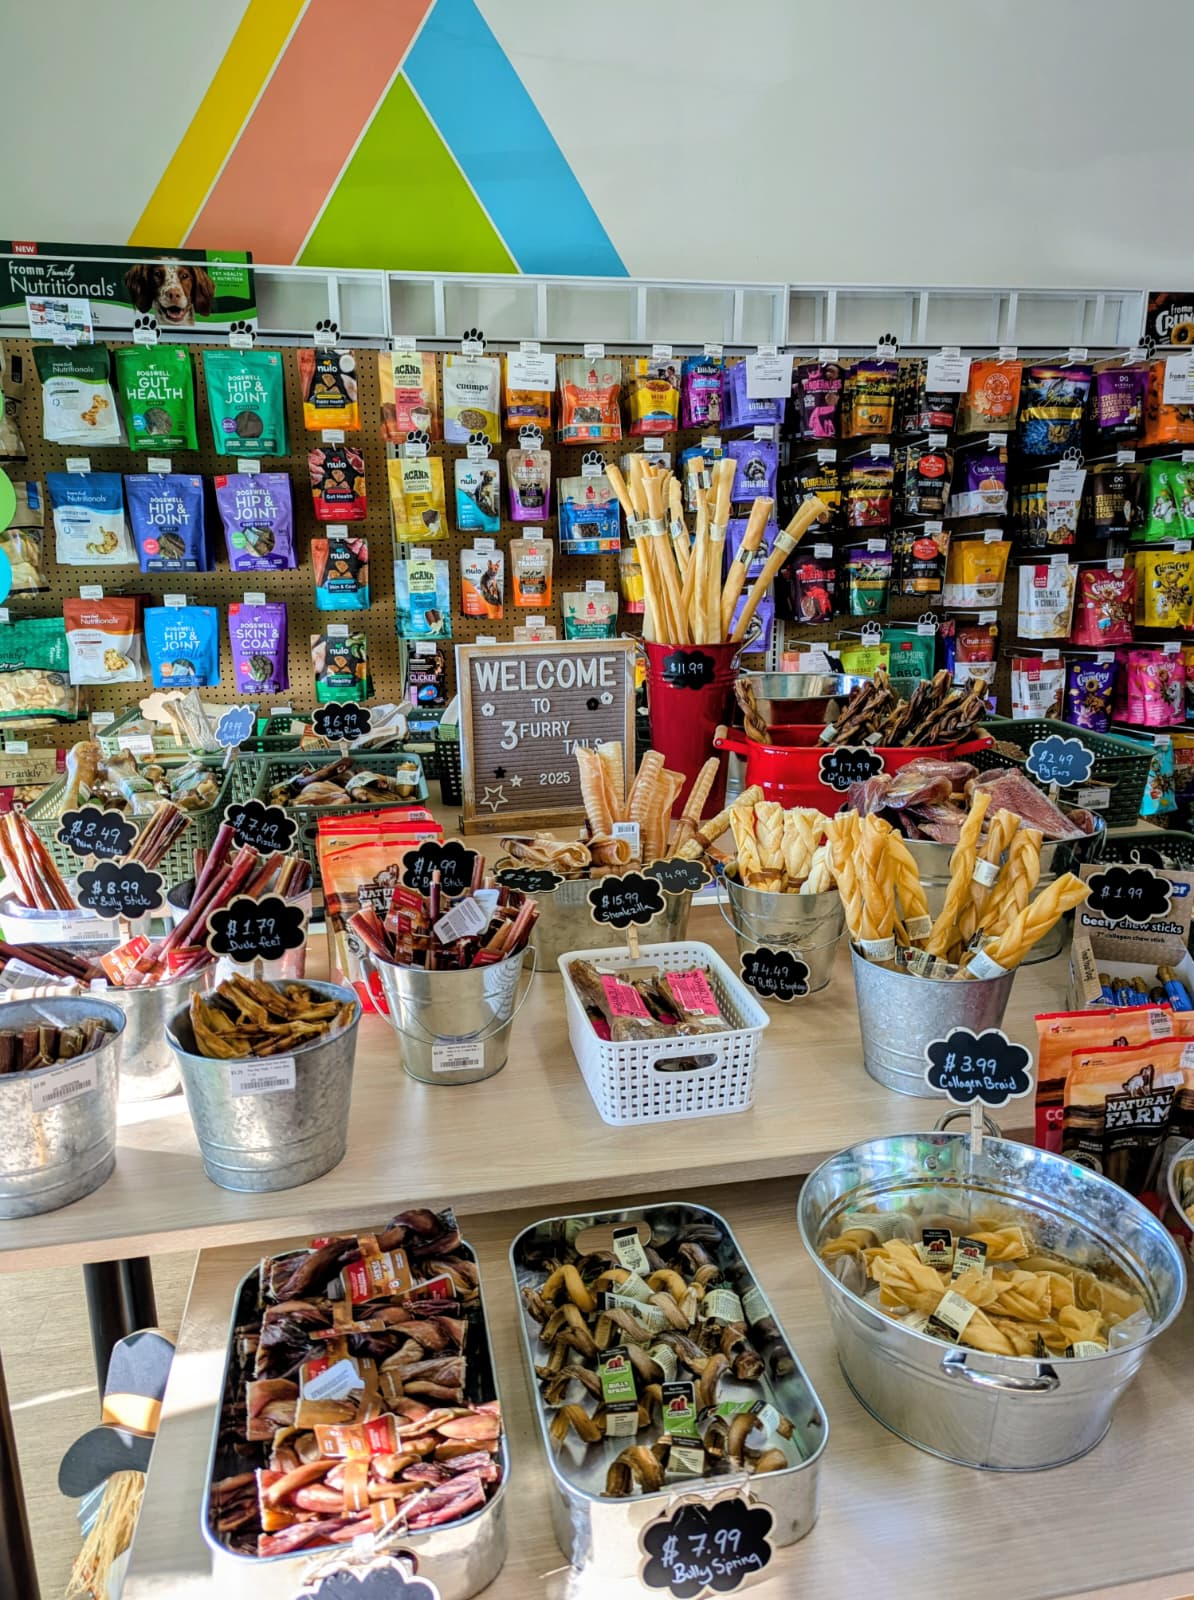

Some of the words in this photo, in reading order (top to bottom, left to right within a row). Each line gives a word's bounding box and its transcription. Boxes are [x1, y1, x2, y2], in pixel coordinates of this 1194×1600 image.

[8, 260, 45, 275] fromm
[46, 263, 75, 281] Family
[10, 276, 116, 297] Nutritionals
[317, 364, 338, 373] nulo
[395, 364, 421, 375] ACANA
[139, 377, 169, 388] GUT
[228, 380, 251, 393] HIP
[254, 381, 264, 391] &
[127, 388, 183, 400] HEALTH
[225, 392, 268, 404] JOINT
[326, 460, 347, 469] nulo
[403, 470, 430, 481] ACANA
[460, 476, 478, 485] nulo
[236, 495, 260, 508] HIP
[263, 496, 274, 507] &
[149, 503, 174, 515] HIP
[177, 503, 186, 514] &
[233, 507, 279, 521] JOINT
[146, 513, 191, 525] JOINT
[330, 551, 350, 560] nulo
[409, 571, 434, 581] ACANA
[465, 567, 482, 575] nulo
[164, 631, 187, 641] HIP
[189, 632, 198, 641] &
[236, 629, 267, 639] SKIN
[270, 628, 280, 638] &
[162, 640, 201, 651] JOINT
[241, 638, 276, 649] COAT
[329, 647, 349, 655] nulo
[474, 656, 617, 692] WELCOME
[670, 661, 704, 676] $11.99
[531, 697, 551, 714] TO
[500, 720, 519, 750] 3
[520, 720, 570, 739] FURRY
[5, 768, 41, 779] Frankly
[1038, 763, 1051, 778] Pig
[1051, 766, 1070, 777] Ears
[539, 771, 571, 786] 2025
[359, 887, 396, 899] NATU
[100, 895, 123, 911] Bully
[1082, 914, 1117, 930] beefy
[1119, 920, 1150, 930] chew
[1151, 922, 1183, 935] sticks
[943, 1052, 997, 1075] $3.99
[939, 1073, 983, 1094] Collagen
[984, 1075, 1018, 1091] Braid
[1107, 1095, 1173, 1112] NATURAL
[1105, 1104, 1171, 1130] FARM
[661, 1528, 742, 1568] $7.99
[672, 1562, 714, 1586] Bully
[712, 1552, 763, 1576] Spring
